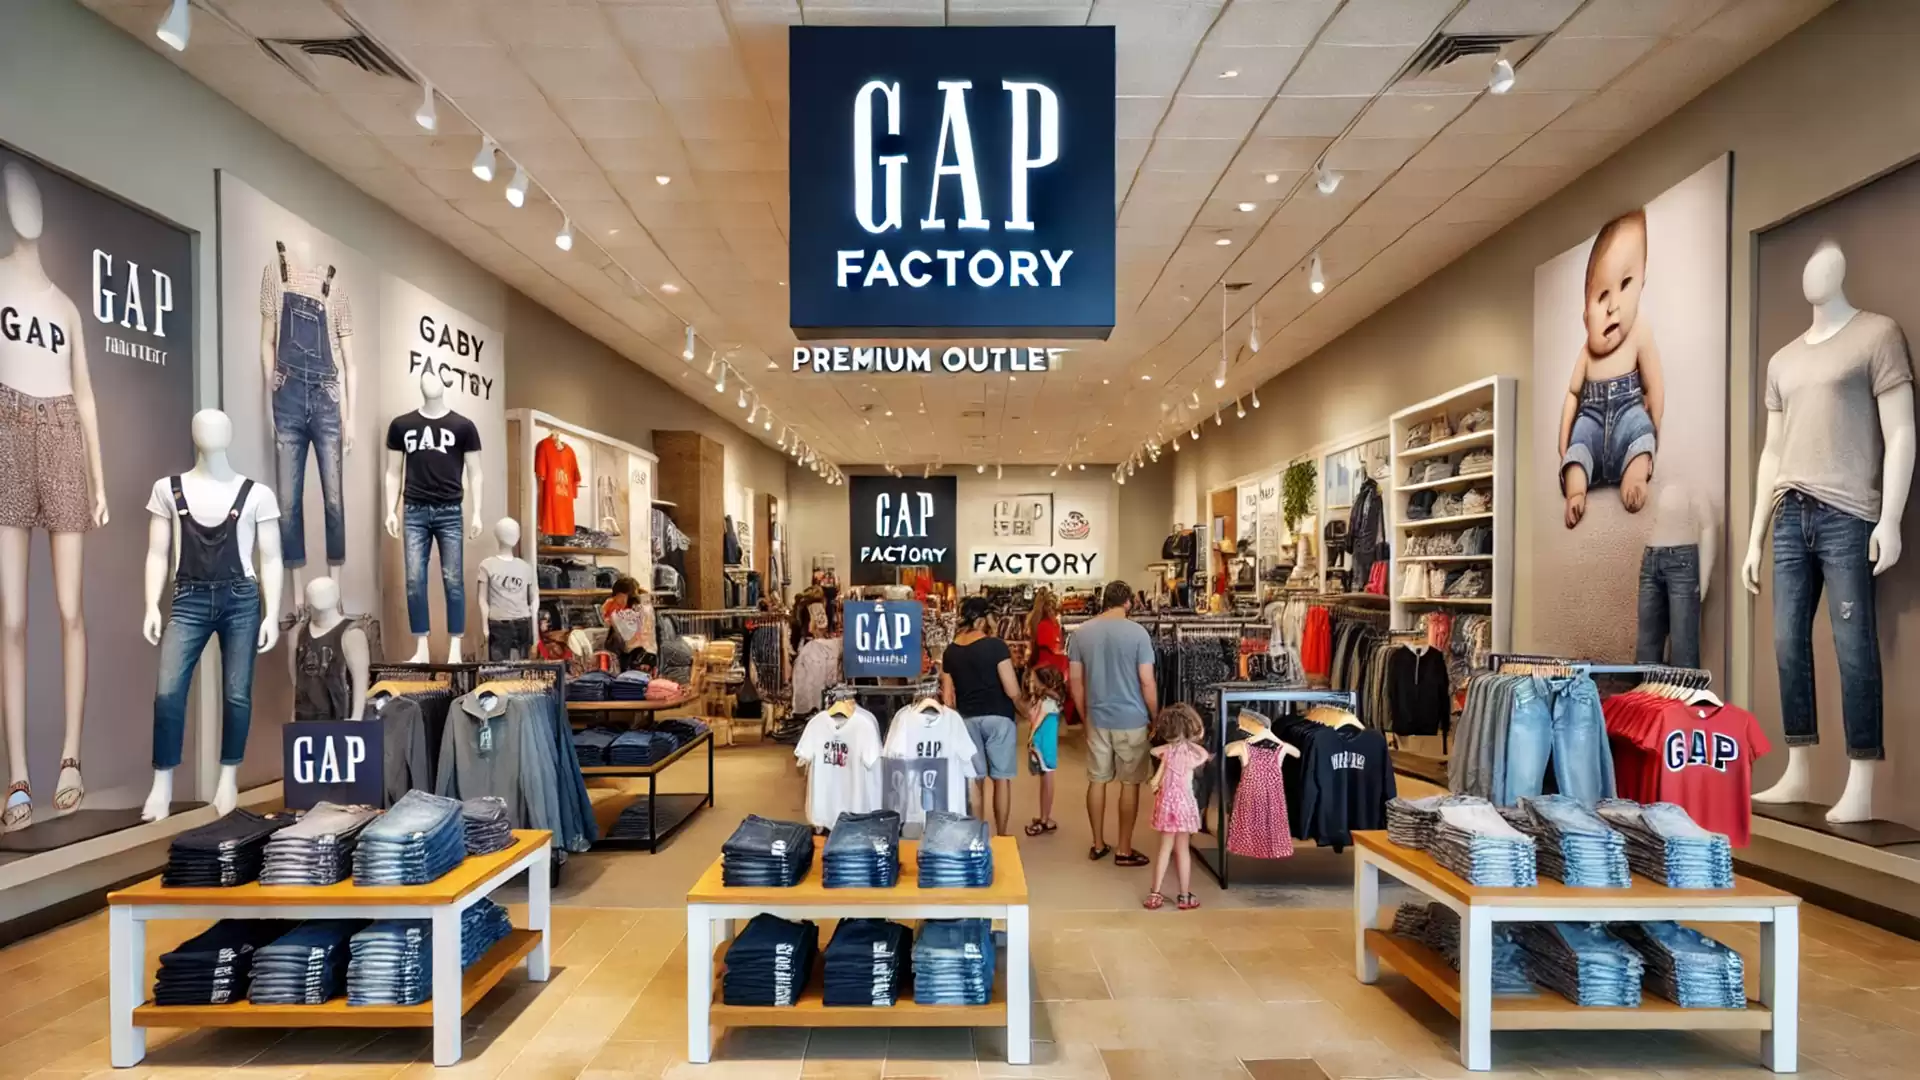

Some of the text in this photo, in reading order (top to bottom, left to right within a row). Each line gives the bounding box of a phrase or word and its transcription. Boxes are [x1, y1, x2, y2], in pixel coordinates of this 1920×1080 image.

[854, 80, 1059, 234] GAP
[837, 249, 1074, 287] FACTORY
[92, 248, 173, 338] GAP
[1, 306, 65, 354] GAP
[419, 315, 484, 363] GABY
[792, 346, 932, 373] PREMIUM
[403, 425, 456, 454] GAP
[973, 552, 1098, 576] FACTORY
[855, 612, 912, 651] GAP
[293, 735, 366, 784] GAP
[1663, 729, 1739, 773] GAP
